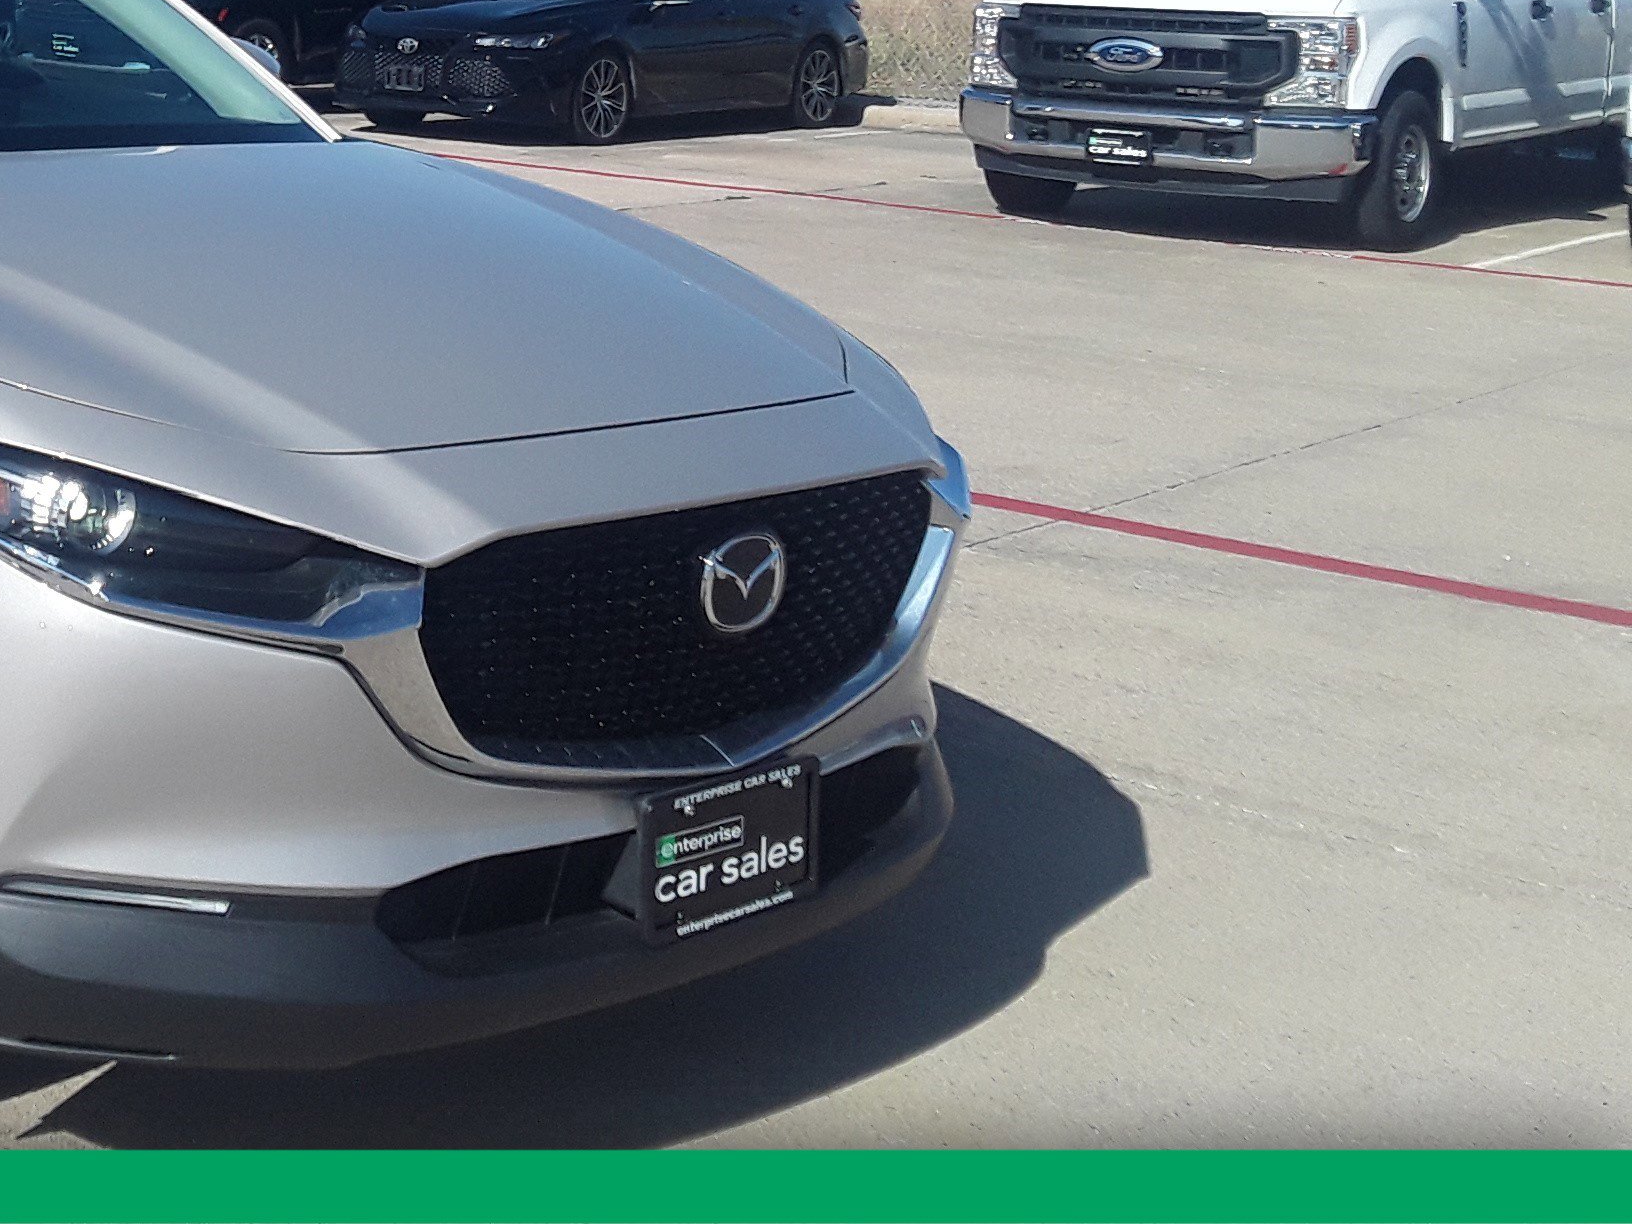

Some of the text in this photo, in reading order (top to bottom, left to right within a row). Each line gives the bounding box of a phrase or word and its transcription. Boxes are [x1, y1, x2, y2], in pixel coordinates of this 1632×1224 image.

[672, 780, 743, 810] ENTERPRISE
[660, 825, 742, 858] enterprise
[654, 834, 805, 903] car sales
